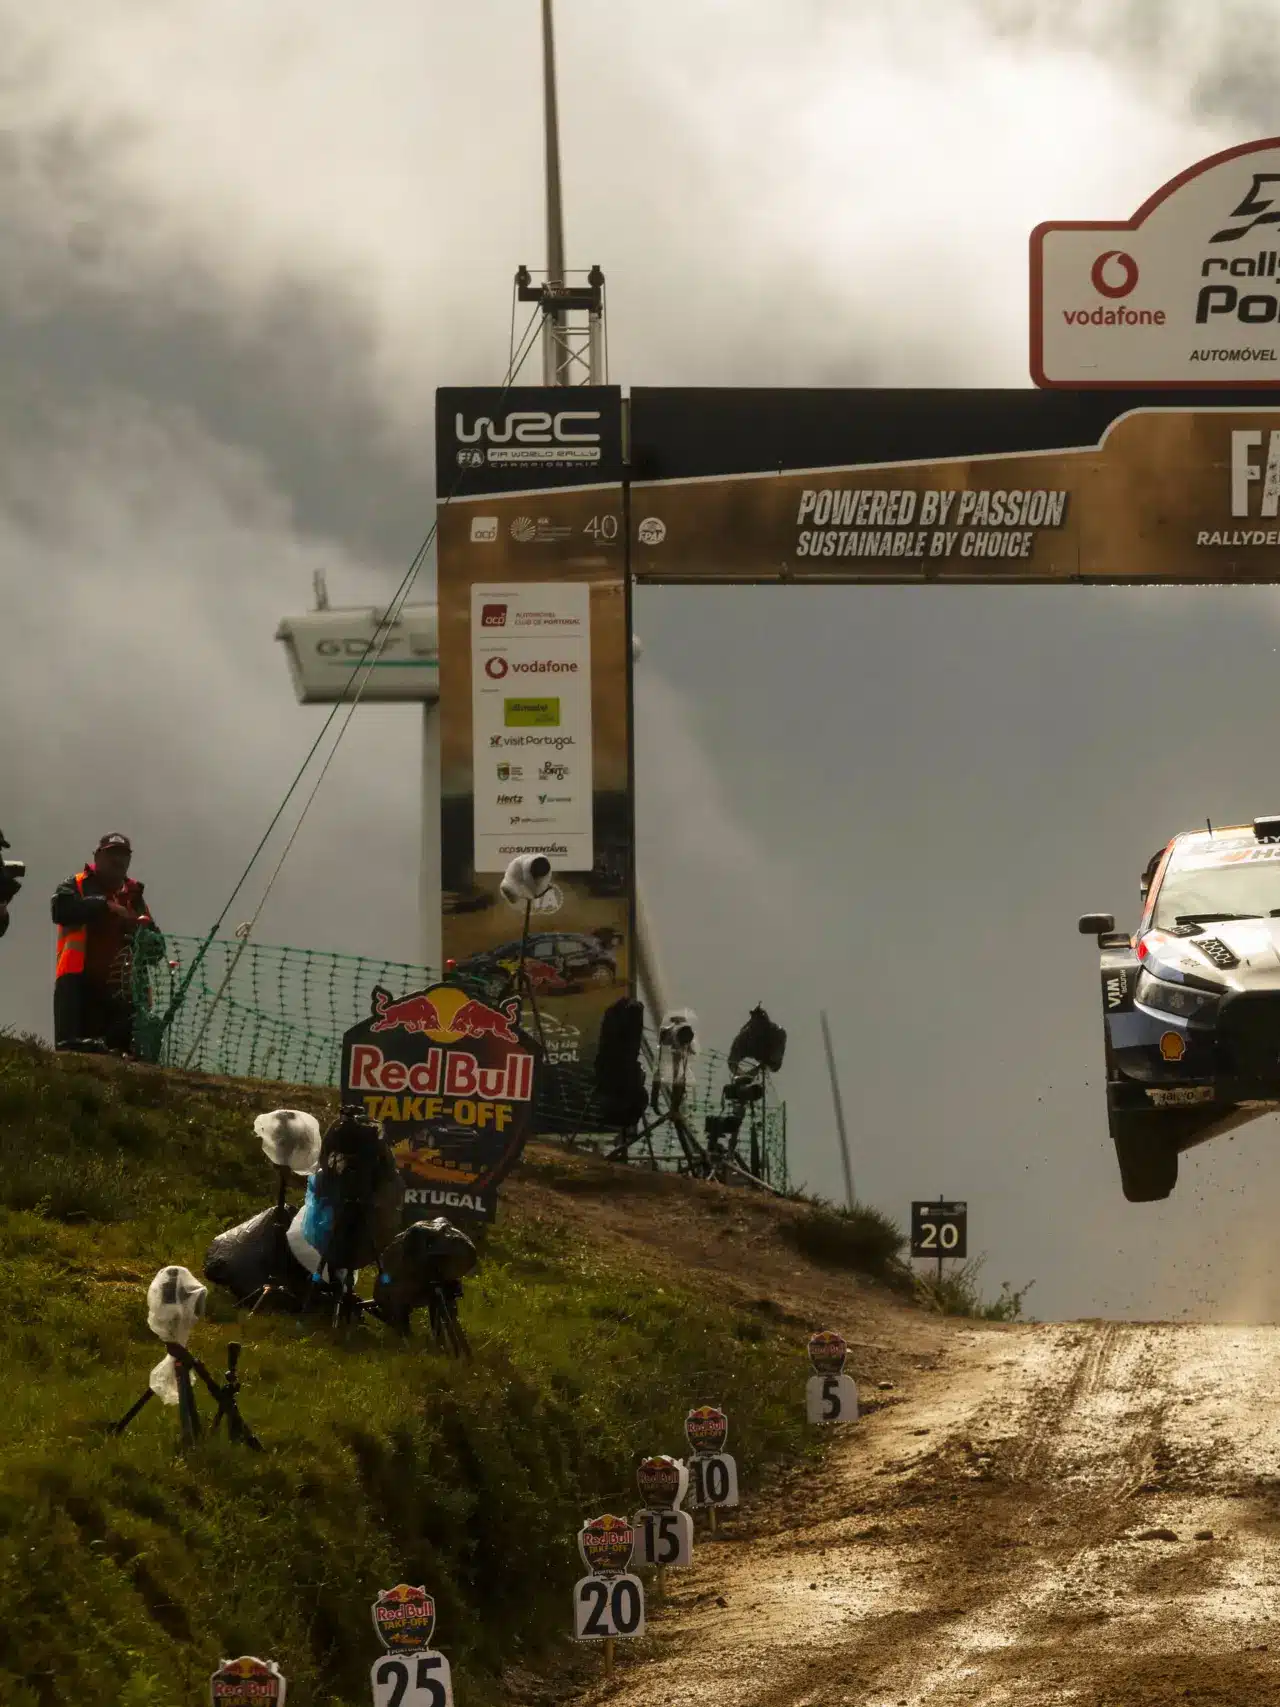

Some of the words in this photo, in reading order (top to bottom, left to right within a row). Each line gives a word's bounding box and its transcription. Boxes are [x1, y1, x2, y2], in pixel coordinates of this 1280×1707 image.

[1063, 306, 1166, 326] vodafone
[1189, 346, 1278, 362] AUTOMÓVEL
[455, 411, 601, 443] WRC
[796, 490, 917, 526] POWERED
[920, 490, 957, 526] BY
[957, 490, 1067, 526] PASSION
[474, 530, 495, 541] acp
[583, 515, 618, 539] 40
[796, 531, 927, 557] SUSTAINABLE
[929, 532, 958, 557] BY
[960, 532, 1033, 557] CHOICE
[485, 616, 505, 626] acp
[512, 660, 578, 673] vodafone
[496, 794, 523, 804] Hertz
[348, 1044, 443, 1095] Red
[444, 1050, 534, 1101] Bull
[363, 1095, 513, 1132] TAKE-OFF
[404, 1189, 487, 1213] RTUGAL
[920, 1223, 959, 1249] 20
[822, 1380, 842, 1420] 5
[691, 1459, 730, 1503] 10
[583, 1531, 608, 1546] Red
[609, 1530, 633, 1545] Bull
[640, 1515, 680, 1564] 15
[376, 1603, 405, 1622] Red
[405, 1601, 434, 1619] Bull
[580, 1581, 641, 1636] 20
[214, 1680, 246, 1698] Red
[247, 1679, 278, 1697] Bull
[376, 1657, 447, 1707] 25
